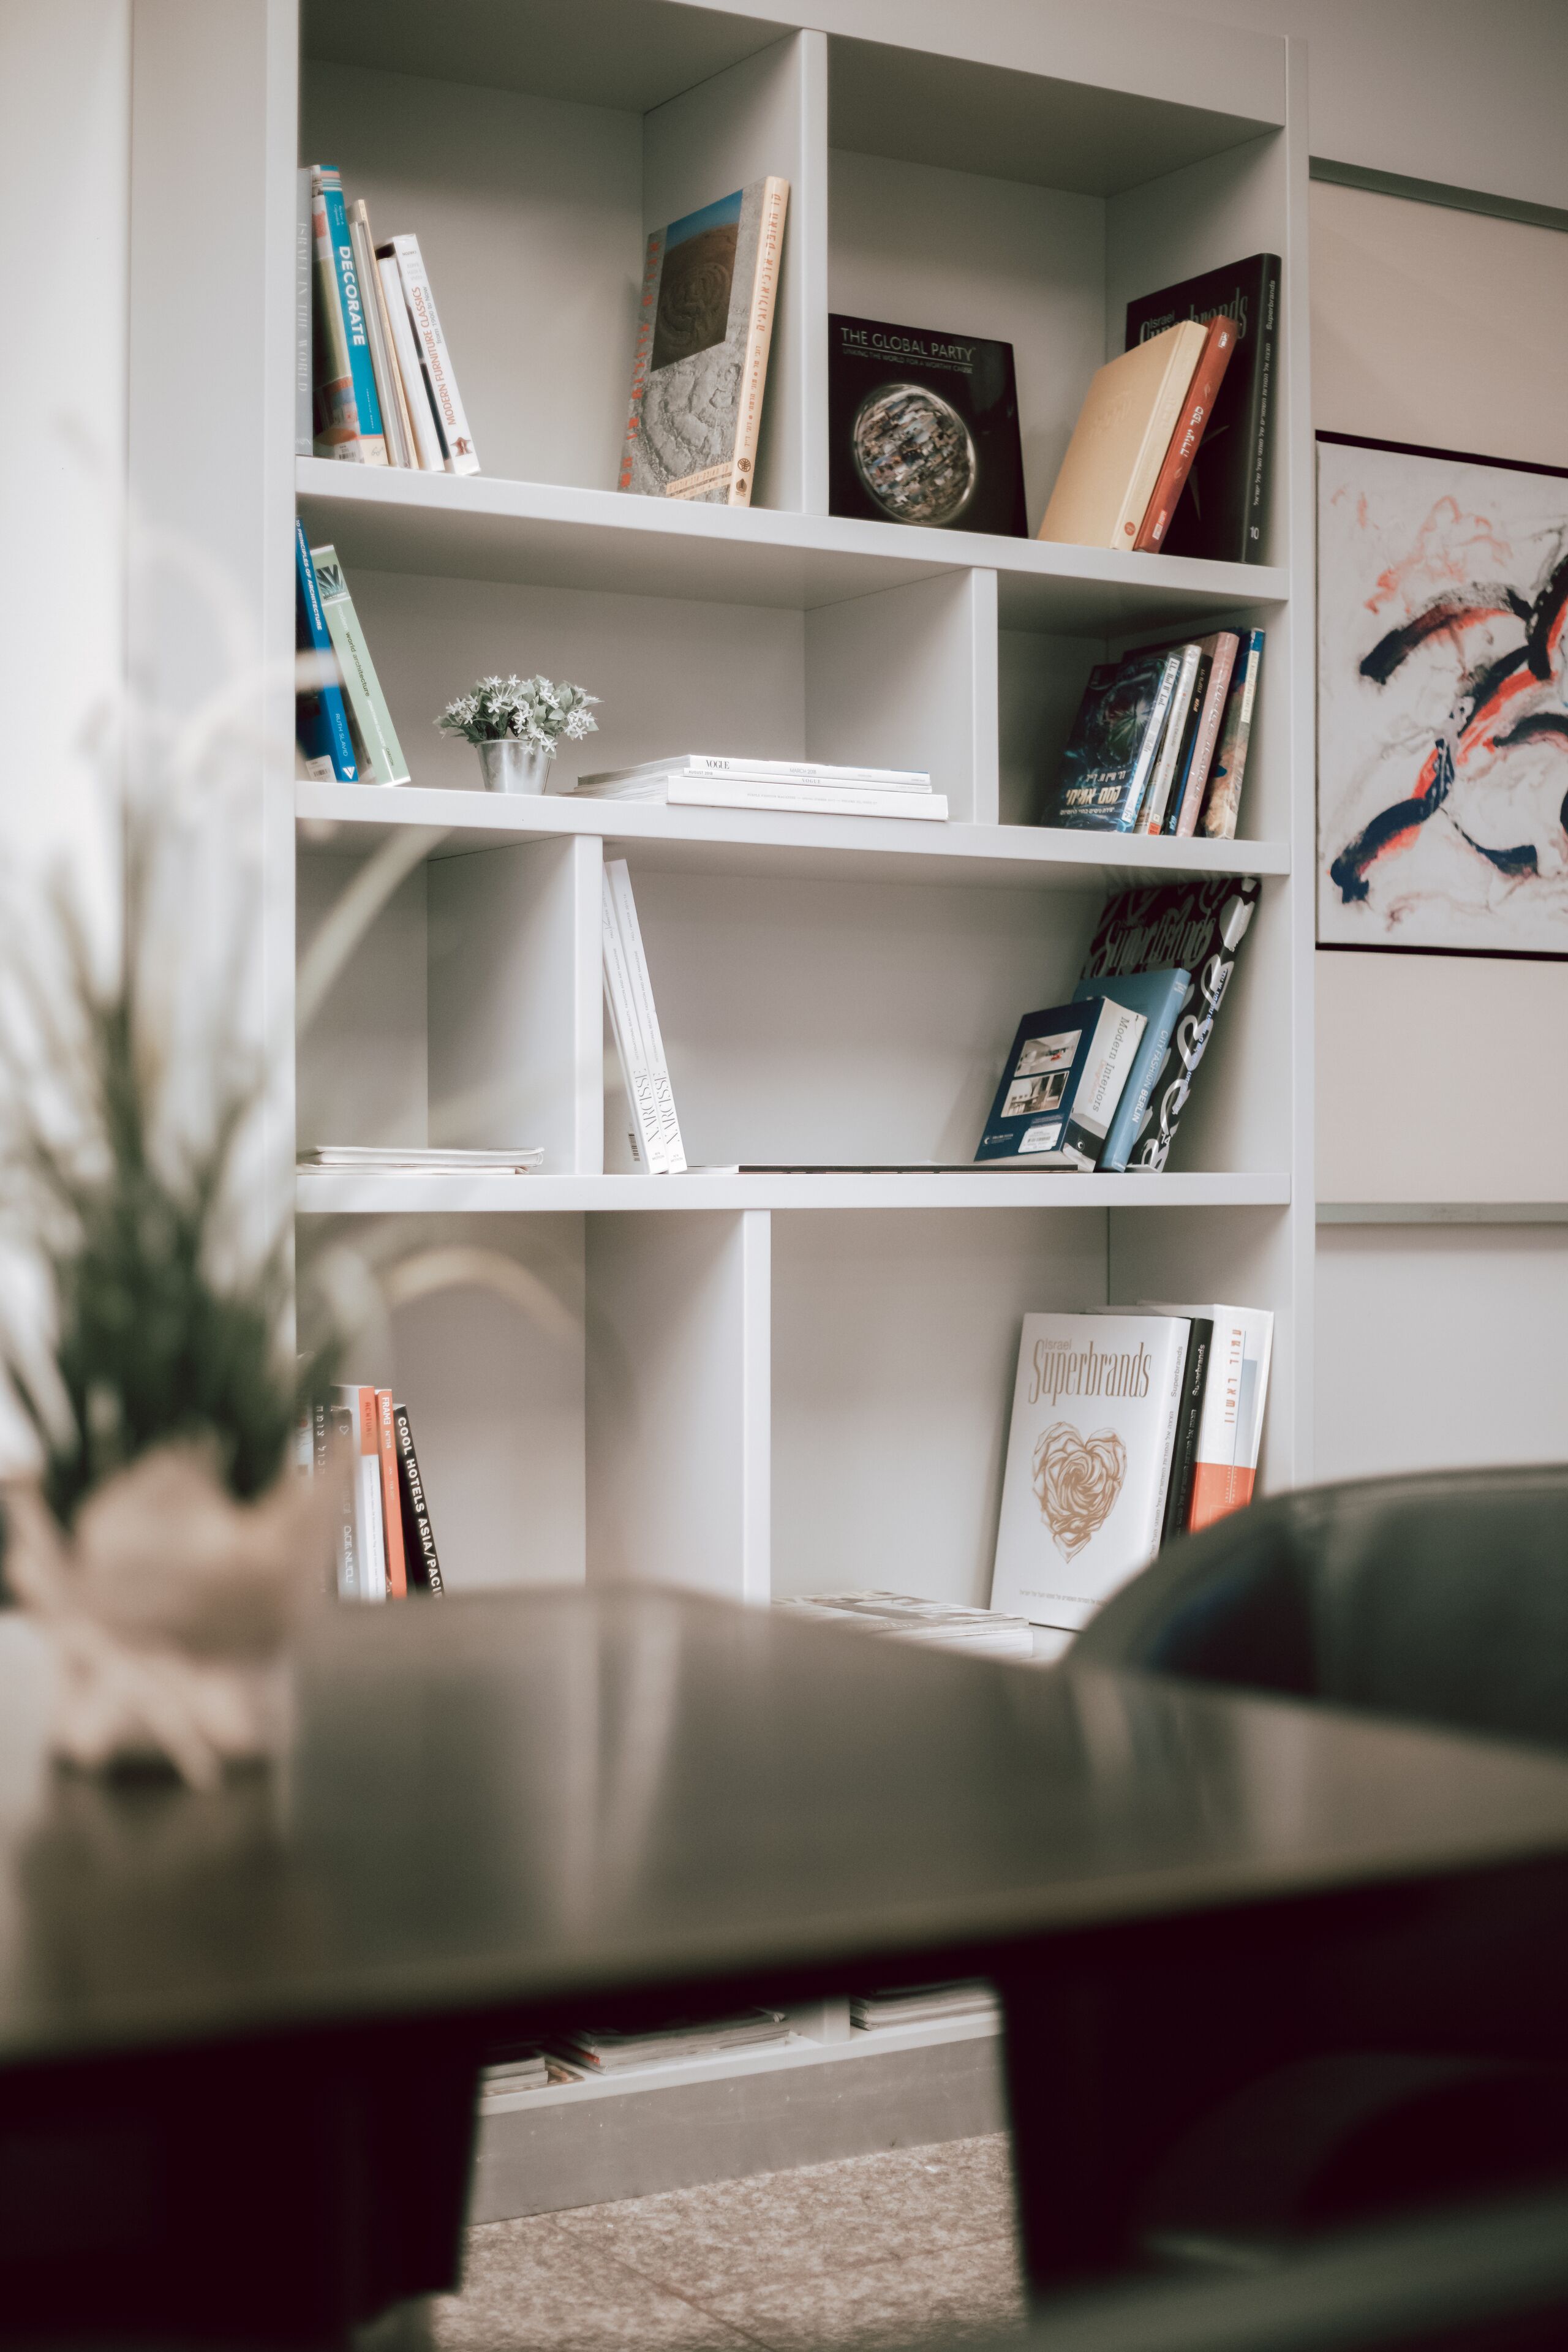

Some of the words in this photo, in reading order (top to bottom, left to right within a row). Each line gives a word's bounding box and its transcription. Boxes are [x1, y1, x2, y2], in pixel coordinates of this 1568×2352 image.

[298, 222, 307, 270] ISRAEL
[298, 281, 307, 295] IN
[339, 246, 366, 346] DECORATE
[412, 287, 429, 328] CLASSICS
[1265, 280, 1276, 331] Superbrands
[298, 303, 307, 331] THE
[423, 330, 445, 382] FURNITURE
[840, 327, 868, 345] THE
[872, 333, 929, 355] GLOBAL
[931, 342, 973, 362] PARTY
[298, 339, 308, 391] WORLD
[437, 383, 456, 426] MODERN
[1190, 405, 1205, 426] ספר
[1180, 429, 1195, 458] יצירה
[297, 528, 309, 567] PRINCIPLES
[1250, 526, 1259, 540] 10
[306, 568, 312, 579] OF
[307, 579, 322, 631] ARCHITECTURE
[337, 604, 349, 631] modern
[345, 631, 356, 652] world
[352, 653, 370, 697] architecture
[339, 733, 348, 757] SLAVID
[706, 760, 729, 770] VOGUE
[1066, 788, 1097, 806] אמיתי
[1098, 785, 1122, 805] קסם
[1109, 1017, 1130, 1060] Modern
[1156, 1030, 1169, 1049] CITY
[1093, 1063, 1115, 1112] Interiors
[1144, 1049, 1163, 1088] FASHION
[633, 1068, 661, 1142] NARCISSE
[653, 1071, 680, 1145] NARCISSE
[1132, 1090, 1149, 1123] BERLIN
[1044, 1338, 1072, 1351] Israel
[1229, 1329, 1243, 1365] עמוד
[1028, 1339, 1152, 1406] Superbrands
[1170, 1346, 1183, 1398] Superbrands
[1192, 1344, 1205, 1396] Superbrands
[364, 1401, 373, 1438] ACHTUNG
[1224, 1378, 1238, 1423] ראשון
[315, 1405, 325, 1436] צומח
[1165, 1430, 1171, 1441] אל
[398, 1416, 412, 1455] COOL
[406, 1459, 425, 1513] HOTELS
